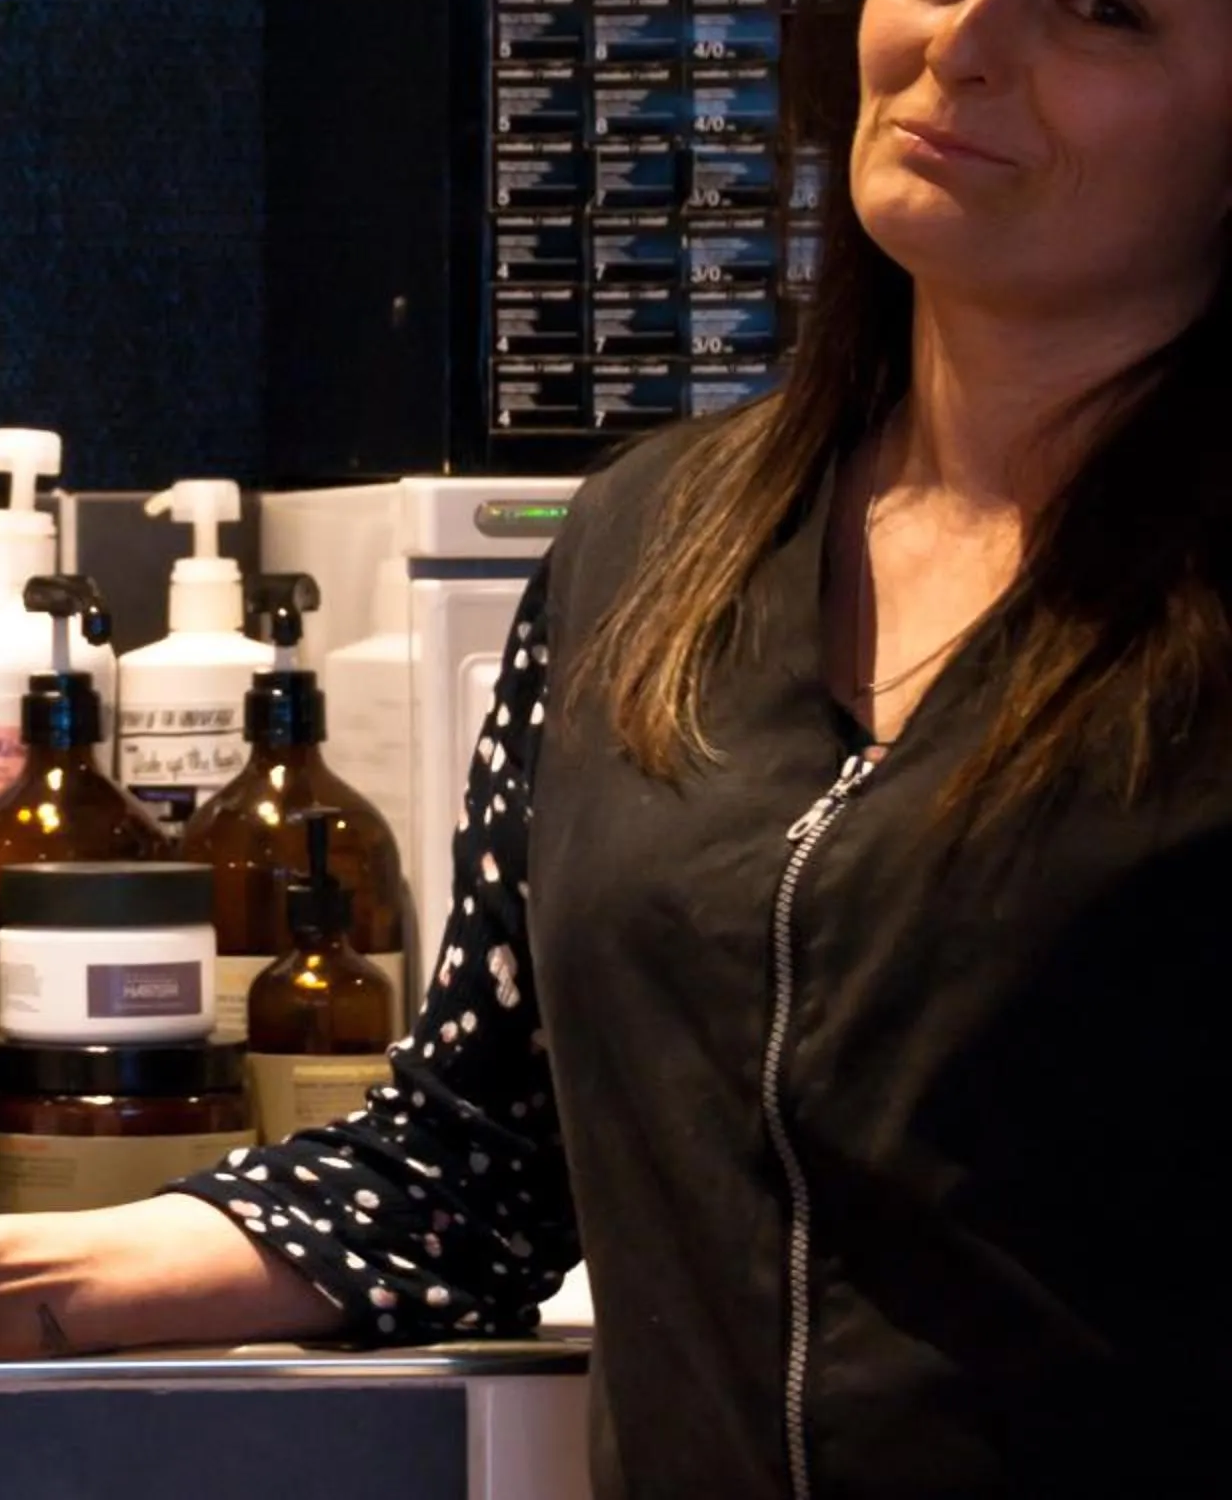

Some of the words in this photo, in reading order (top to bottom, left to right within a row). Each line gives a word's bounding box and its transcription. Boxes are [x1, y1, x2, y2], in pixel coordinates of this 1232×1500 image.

[693, 116, 725, 133] 4/0
[497, 410, 512, 428] 4
[594, 410, 607, 428] 7
